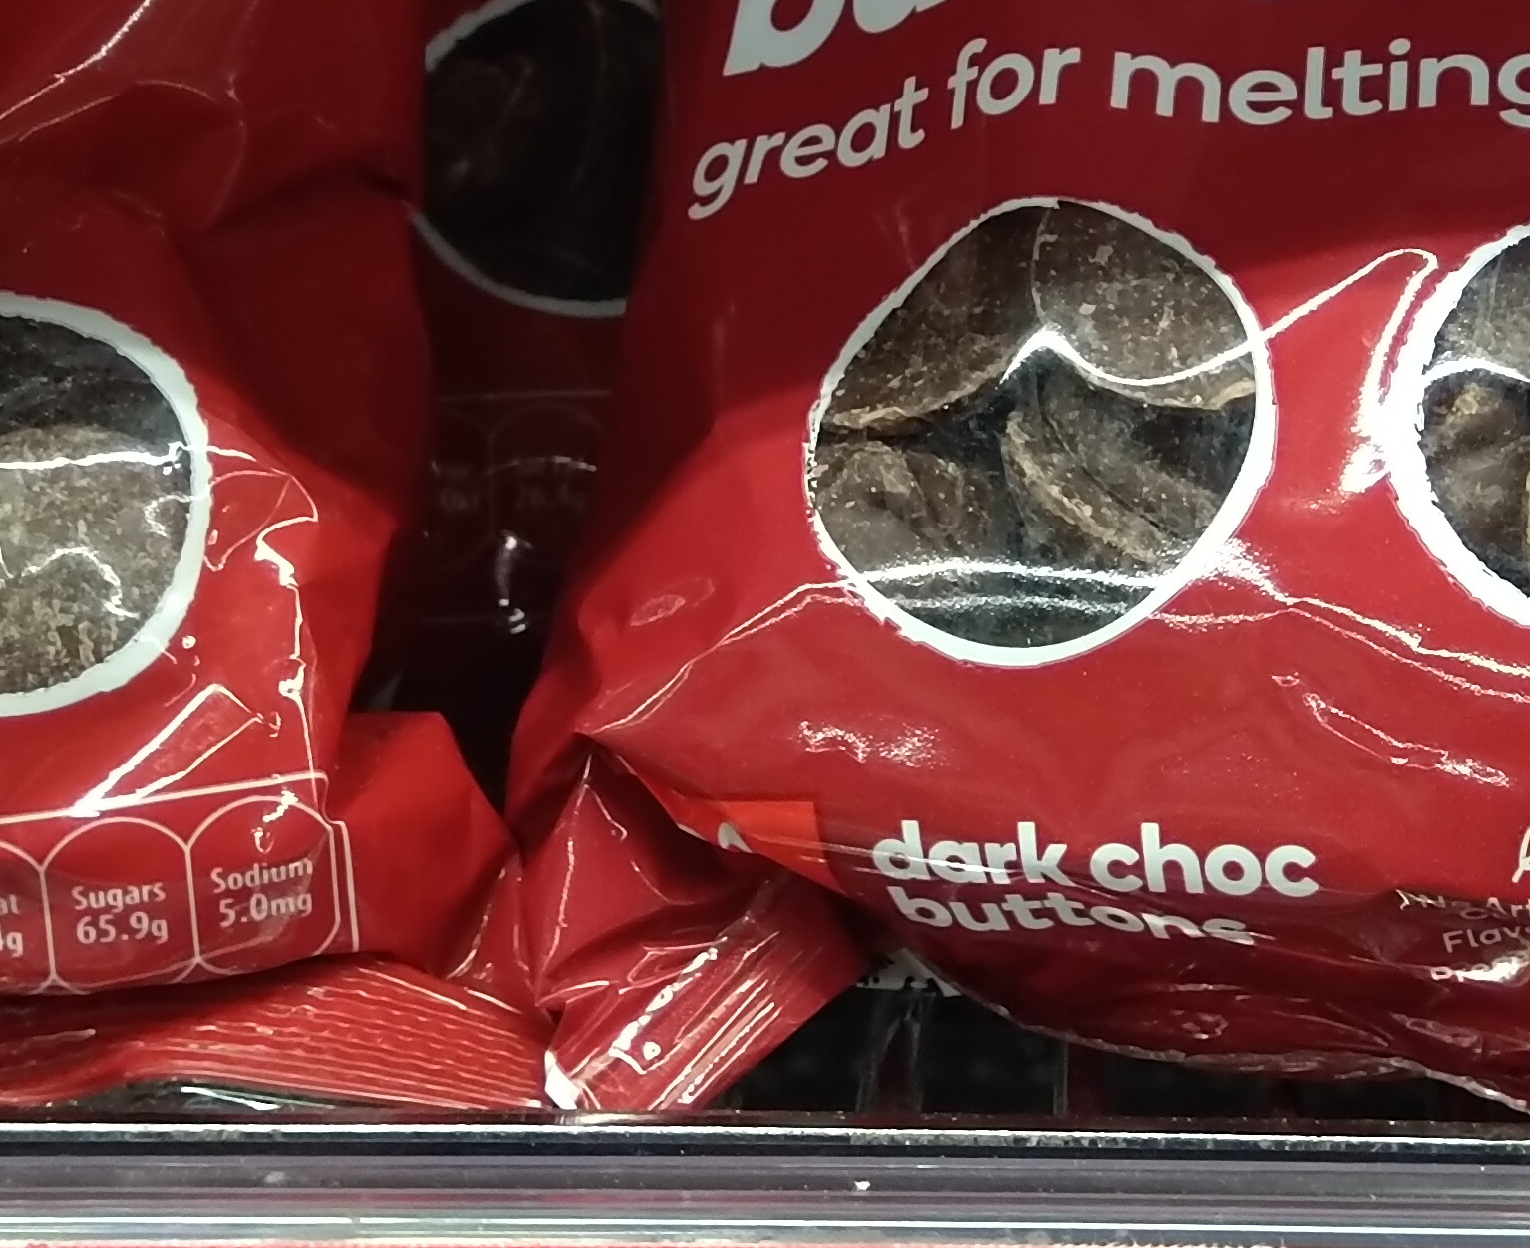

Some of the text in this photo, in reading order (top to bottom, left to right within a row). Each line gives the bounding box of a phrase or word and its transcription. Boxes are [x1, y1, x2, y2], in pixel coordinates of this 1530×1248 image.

[686, 76, 927, 219] great
[947, 36, 1082, 132] for
[210, 856, 313, 895] Sodium
[871, 818, 1321, 898] dark choc
[71, 881, 167, 914] Sugars
[218, 890, 313, 927] 5.0mg
[886, 885, 1259, 947] buttons
[76, 910, 169, 945] 65.9g
